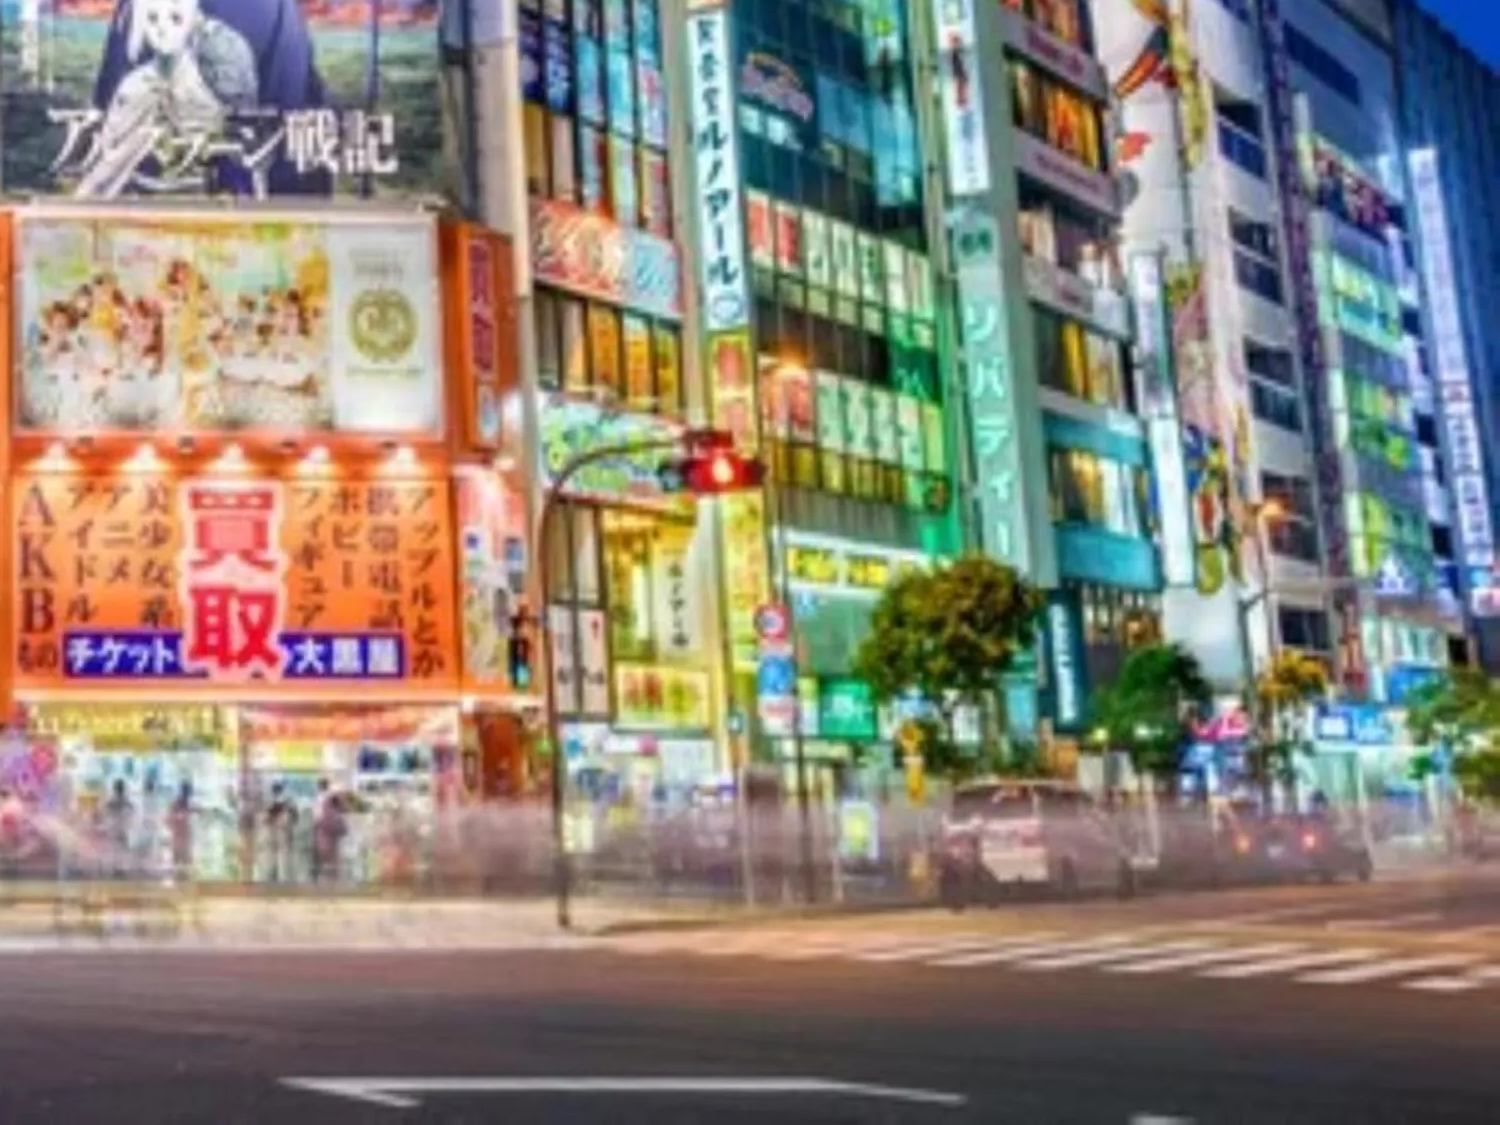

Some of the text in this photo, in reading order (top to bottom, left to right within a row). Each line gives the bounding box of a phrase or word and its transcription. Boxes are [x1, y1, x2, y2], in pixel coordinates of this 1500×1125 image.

[965, 302, 1014, 557] リバティー
[66, 486, 97, 623] アイドル
[102, 486, 134, 585] アニメ
[188, 488, 284, 671] 買取
[68, 637, 176, 675] チケット
